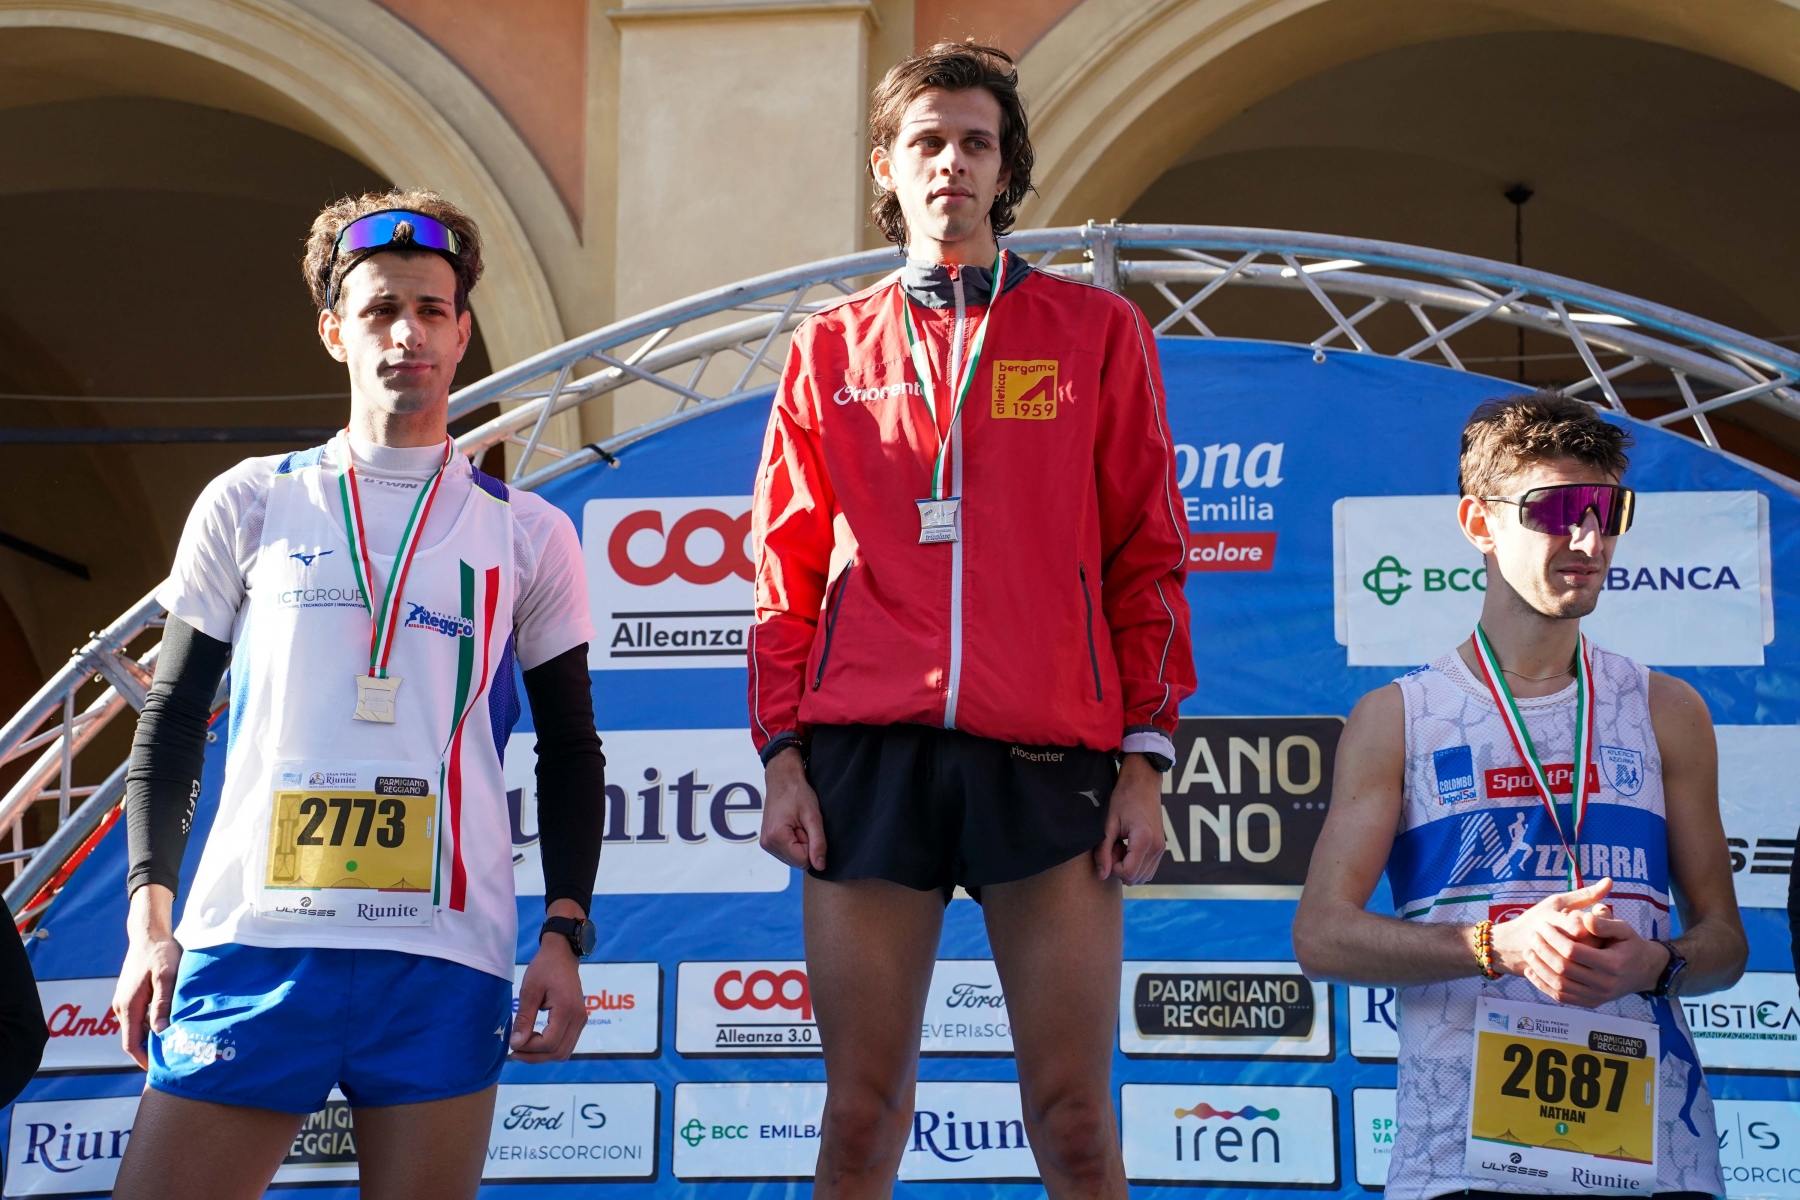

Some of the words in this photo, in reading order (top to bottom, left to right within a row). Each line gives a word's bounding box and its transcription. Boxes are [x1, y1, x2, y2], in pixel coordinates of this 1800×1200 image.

[999, 362, 1056, 377] bergamo
[996, 375, 1006, 414] atletica
[1012, 402, 1055, 417] 1959
[1184, 495, 1274, 521] Emilia
[1189, 541, 1263, 562] colore
[1600, 565, 1742, 591] BANCA
[611, 622, 744, 648] Alleanza
[1010, 745, 1065, 762] riocenter
[325, 776, 357, 786] Riunite
[379, 778, 425, 788] PARMIGIANO
[1439, 775, 1473, 793] COLOMBO
[383, 786, 421, 795] REGGIANO
[297, 797, 406, 848] 2773
[275, 906, 337, 917] ULYSSES
[356, 903, 419, 921] Riunite
[946, 983, 1006, 1009] Ford
[1148, 980, 1300, 1004] PARMIGIANO
[1163, 1004, 1286, 1029] REGGIANO
[716, 1029, 783, 1043] Alleanza
[788, 1028, 812, 1043] 3.0
[1535, 1023, 1569, 1035] Riunite
[1592, 1033, 1643, 1048] PARMIGIANO
[1597, 1042, 1638, 1055] REGGIANO
[1501, 1043, 1629, 1113] 2687
[503, 1104, 565, 1130] Ford
[1540, 1105, 1586, 1124] NATHAN
[711, 1125, 749, 1139] BCC
[1372, 1118, 1399, 1130] SP
[1559, 1123, 1565, 1134] 1
[1175, 1126, 1281, 1164] iren
[1481, 1161, 1549, 1178] ULYSSES
[1571, 1167, 1640, 1190] Riunite
